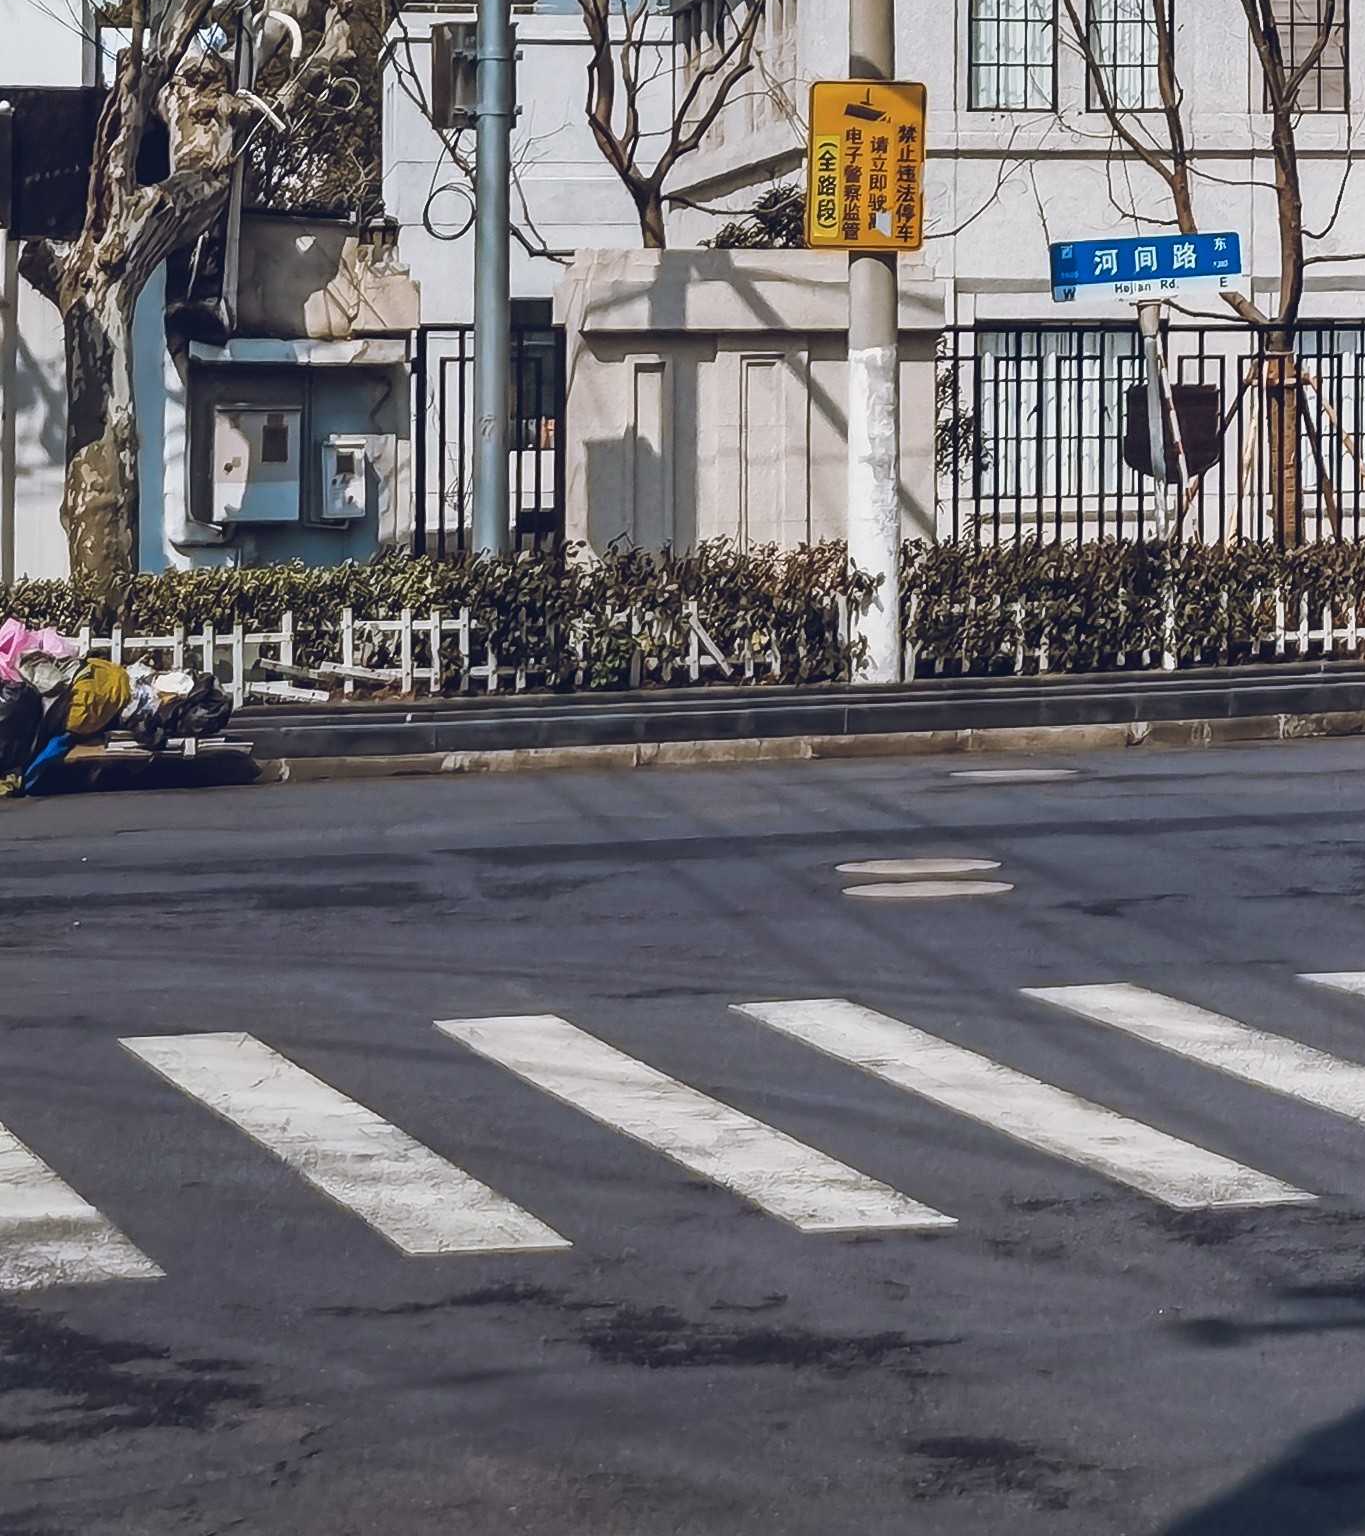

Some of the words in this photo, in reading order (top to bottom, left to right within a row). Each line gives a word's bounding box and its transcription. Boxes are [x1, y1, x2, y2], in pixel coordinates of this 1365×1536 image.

[841, 126, 863, 241] 电子警察监管
[895, 124, 918, 243] 禁止违法停车
[1213, 236, 1227, 251] 东
[1093, 242, 1197, 276] 河间路
[1063, 285, 1077, 302] W
[1219, 276, 1229, 288] E
